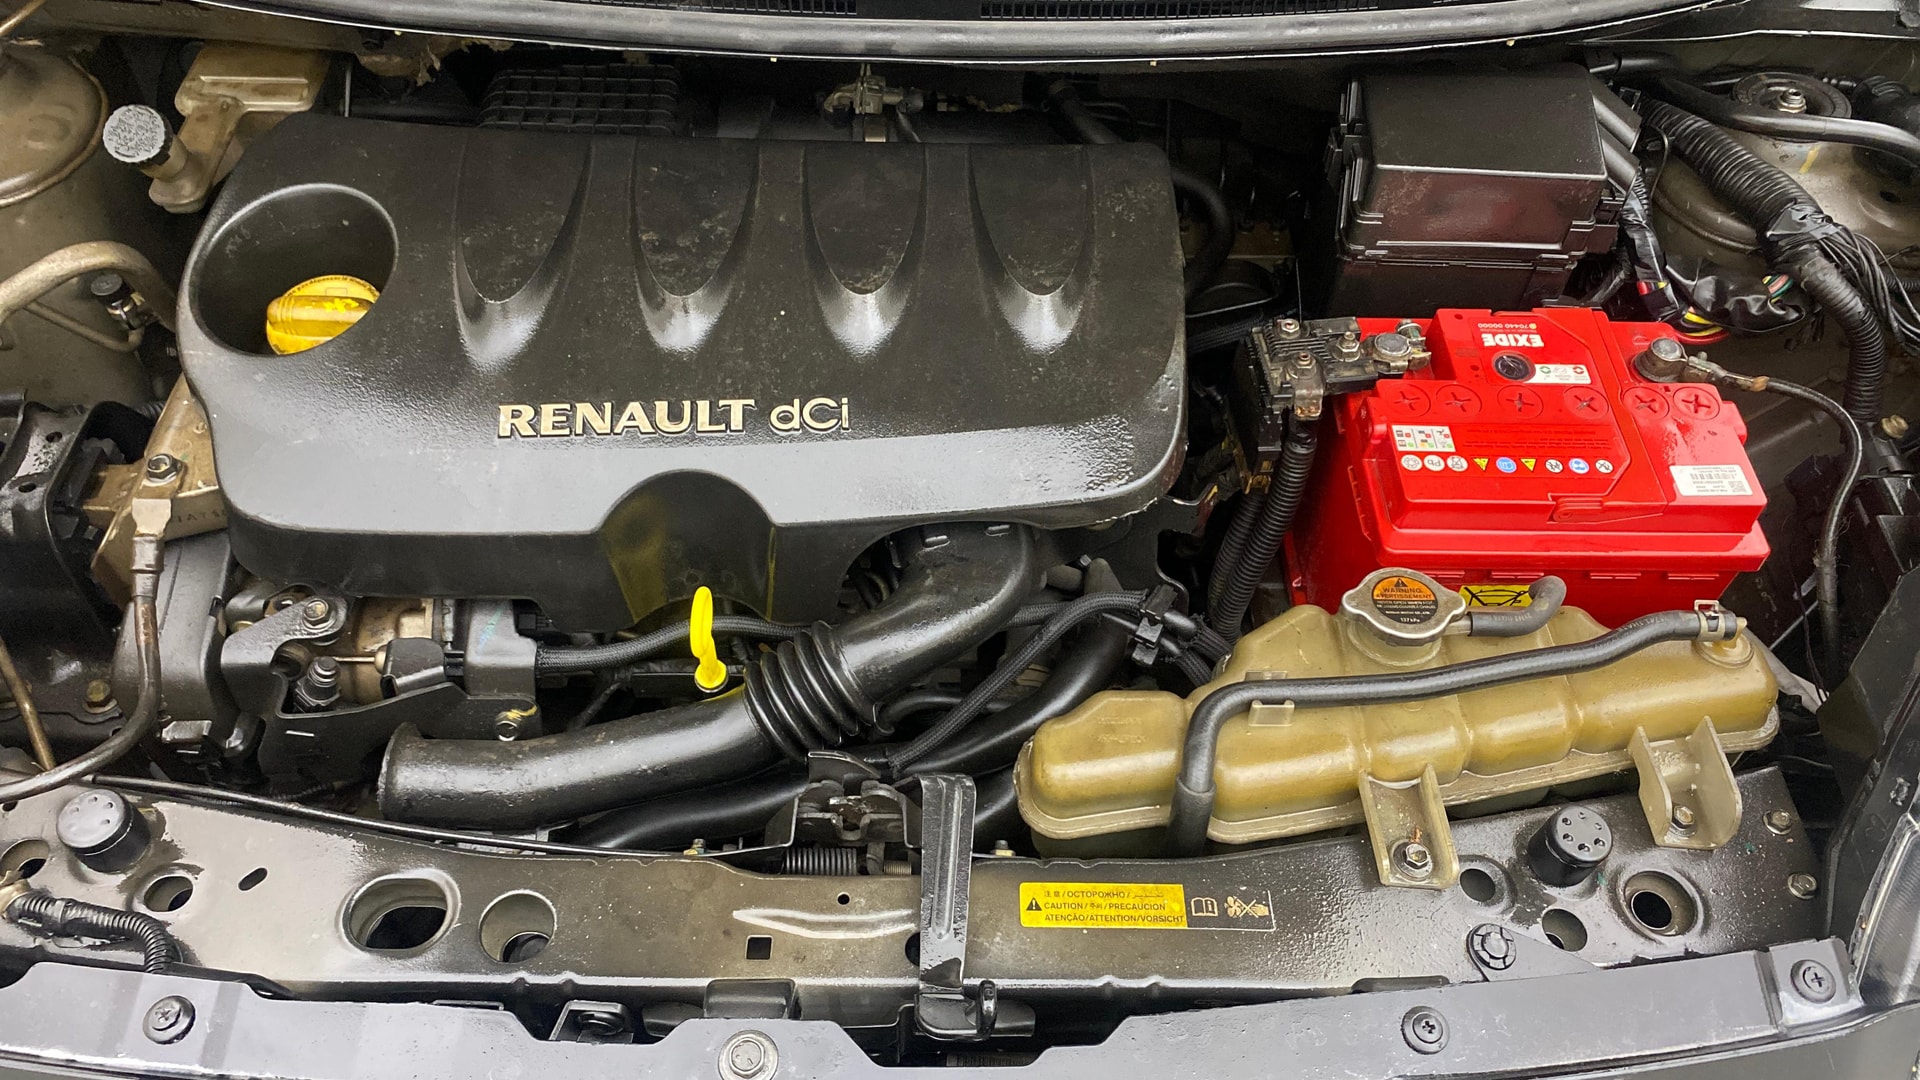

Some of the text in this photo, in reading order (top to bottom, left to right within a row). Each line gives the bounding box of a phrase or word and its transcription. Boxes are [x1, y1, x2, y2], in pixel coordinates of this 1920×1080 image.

[1481, 333, 1544, 347] EXIDE
[498, 397, 850, 438] RENAULT dCi
[1044, 902, 1083, 910] CAUTION
[1108, 903, 1166, 911] PRECAUCION
